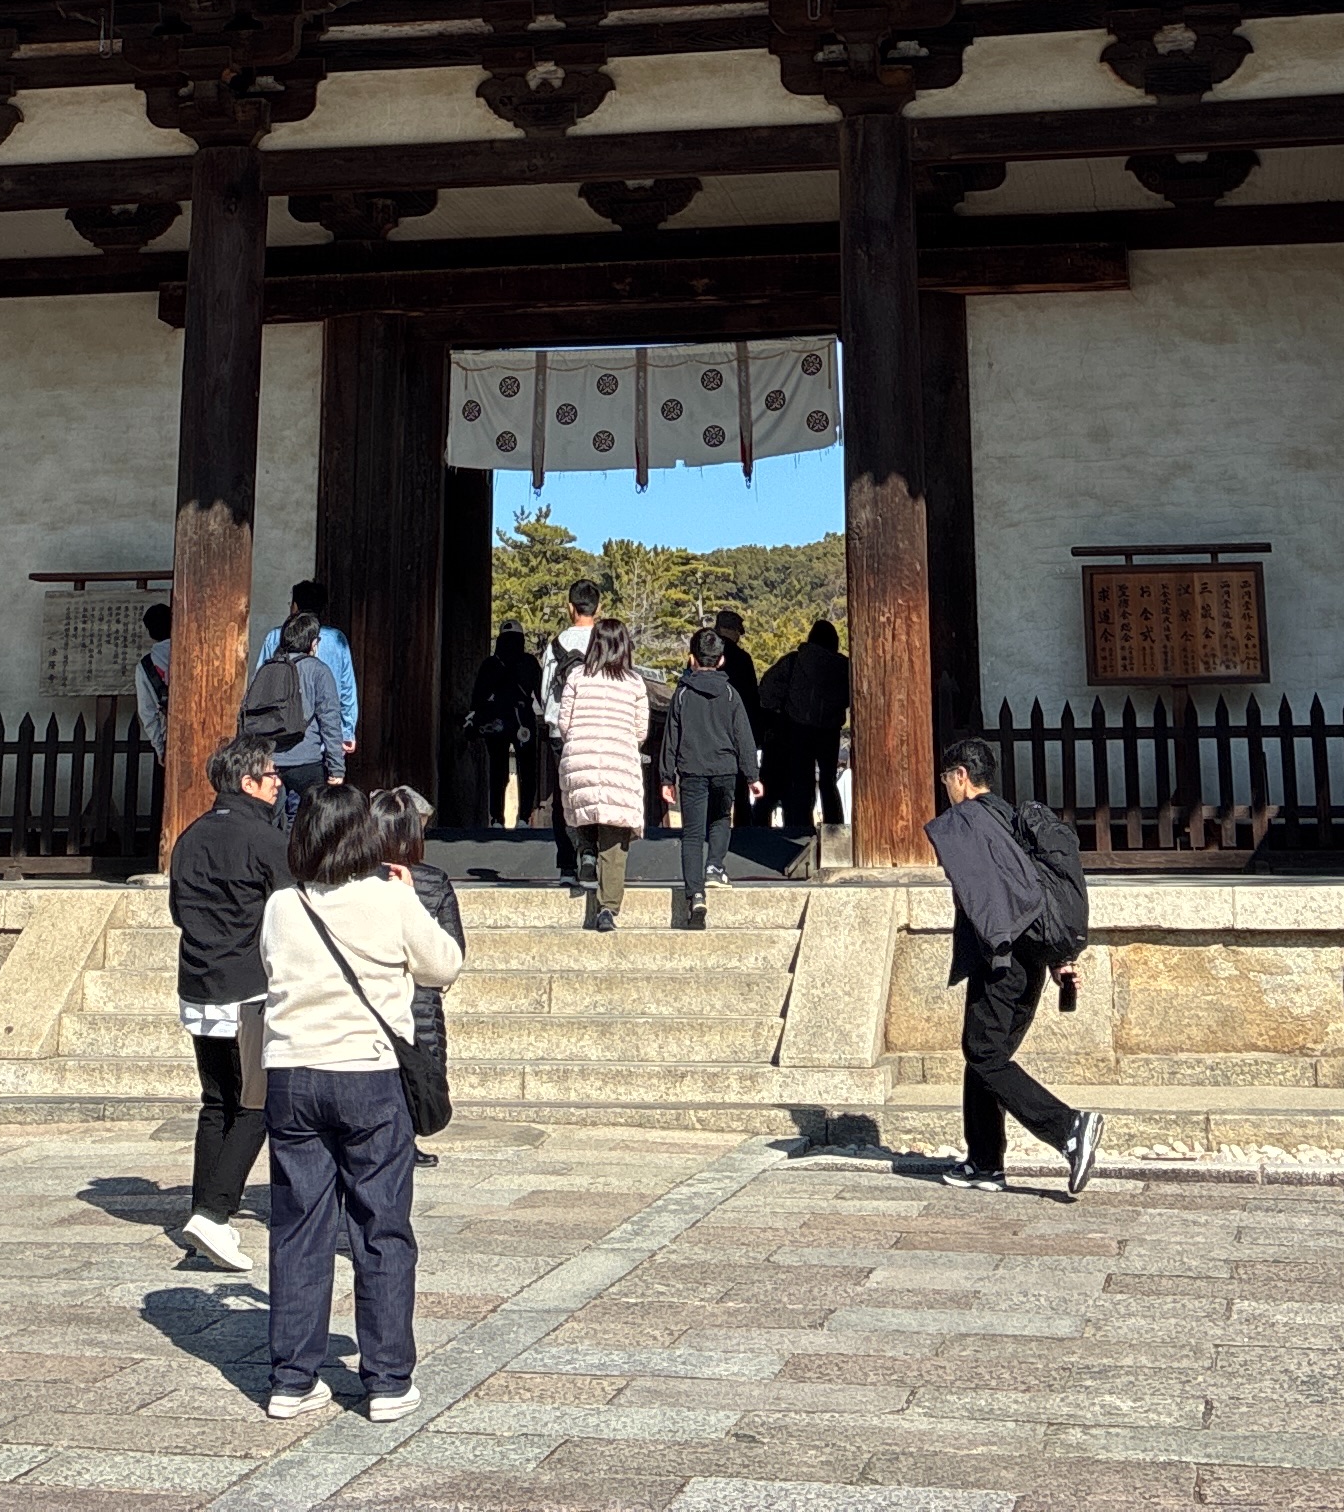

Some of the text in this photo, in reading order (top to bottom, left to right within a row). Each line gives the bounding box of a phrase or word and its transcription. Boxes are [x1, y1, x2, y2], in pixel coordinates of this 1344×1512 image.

[1097, 586, 1115, 643] 求道会
[1139, 585, 1156, 644] お会式
